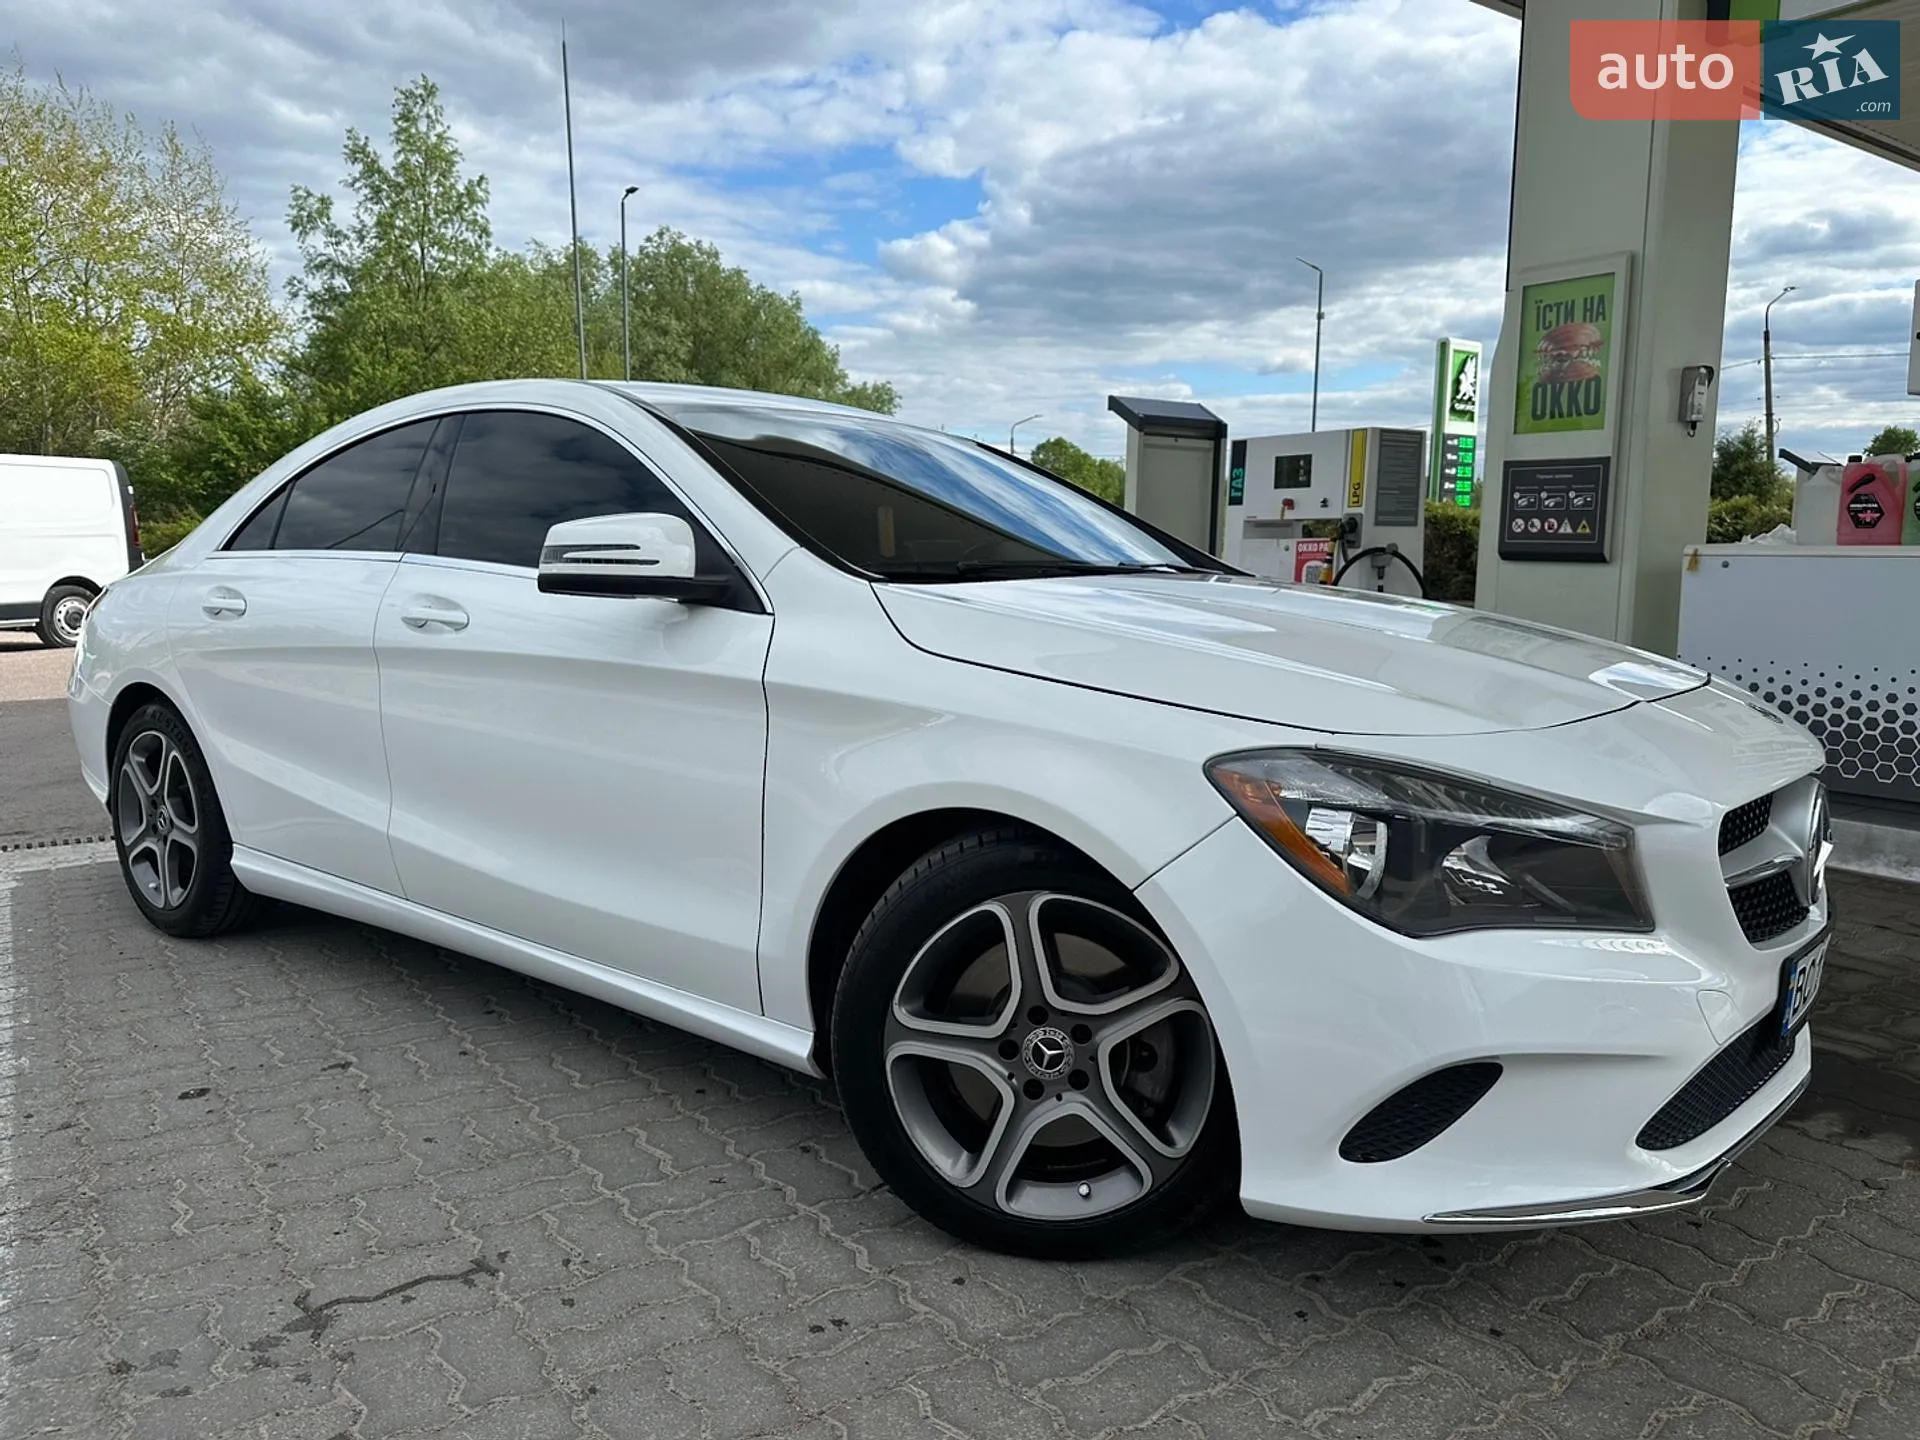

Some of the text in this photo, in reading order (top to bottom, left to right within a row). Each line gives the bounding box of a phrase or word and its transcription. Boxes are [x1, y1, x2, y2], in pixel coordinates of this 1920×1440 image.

[1534, 294, 1606, 332] ЇСТИ НА
[1531, 375, 1602, 421] ОККО
[1231, 467, 1244, 497] ГАЗ
[1352, 482, 1361, 504] LPG
